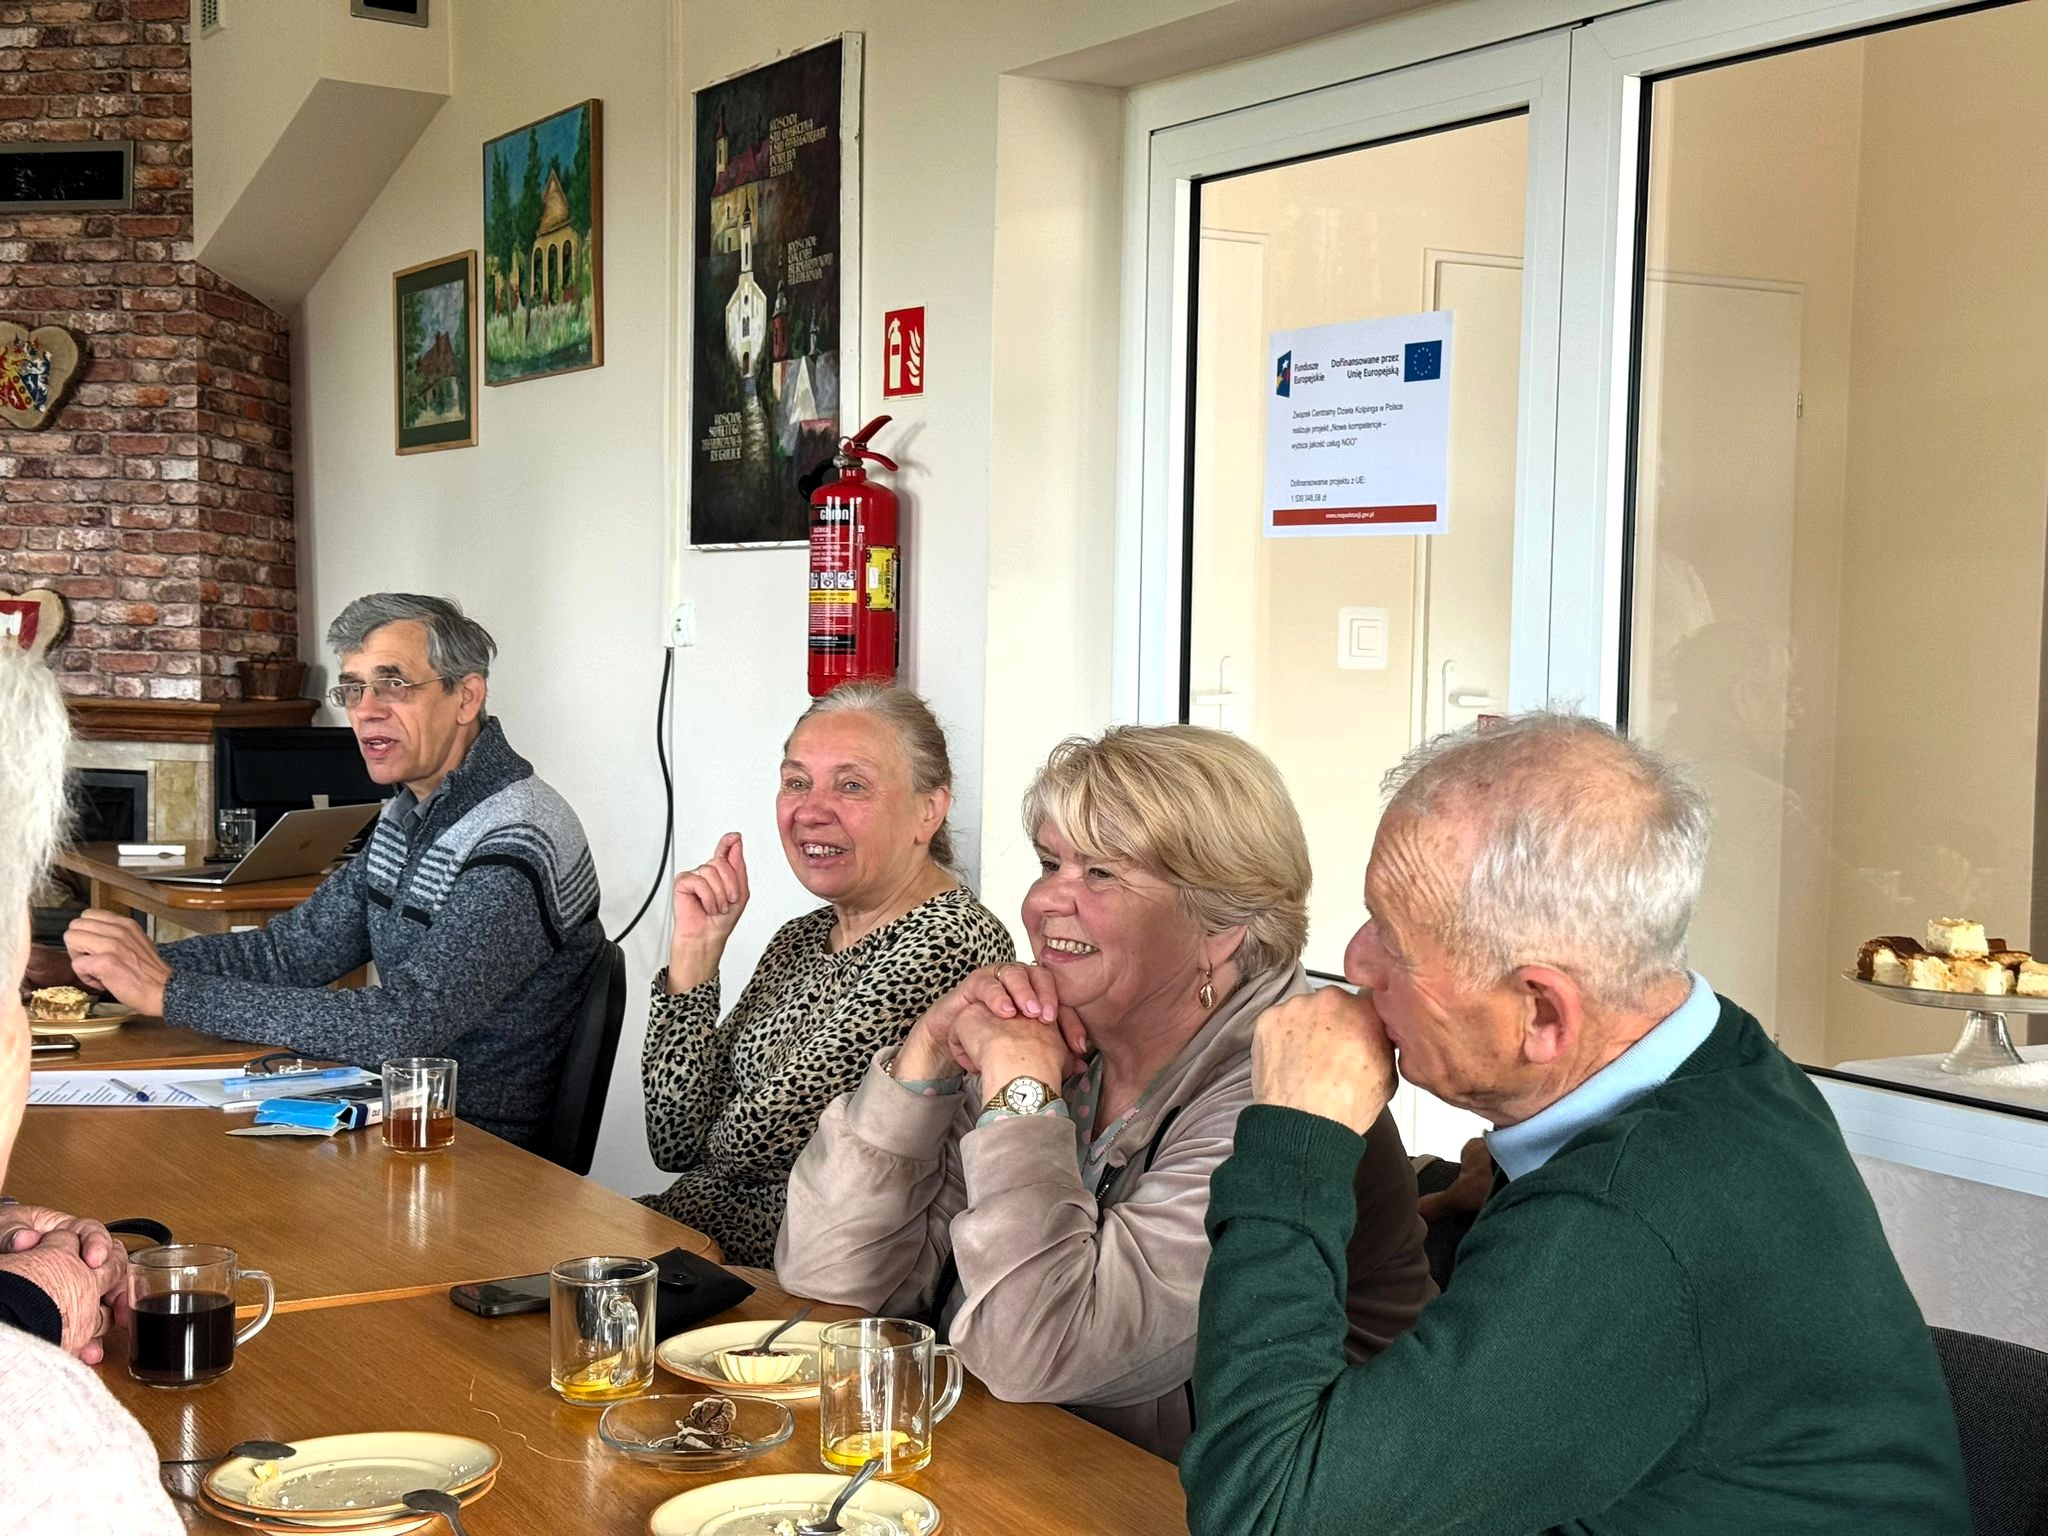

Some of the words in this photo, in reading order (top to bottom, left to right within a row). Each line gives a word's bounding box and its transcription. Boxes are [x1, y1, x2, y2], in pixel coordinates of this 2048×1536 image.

[1331, 356, 1380, 369] Dofinansowane
[1381, 353, 1399, 364] przez
[1294, 362, 1319, 372] Fundusze
[1347, 370, 1362, 379] Unię
[1363, 366, 1399, 379] Europejską
[1294, 373, 1325, 385] Europejskie
[1355, 403, 1378, 414] Kolpinga
[1311, 424, 1329, 434] projekt
